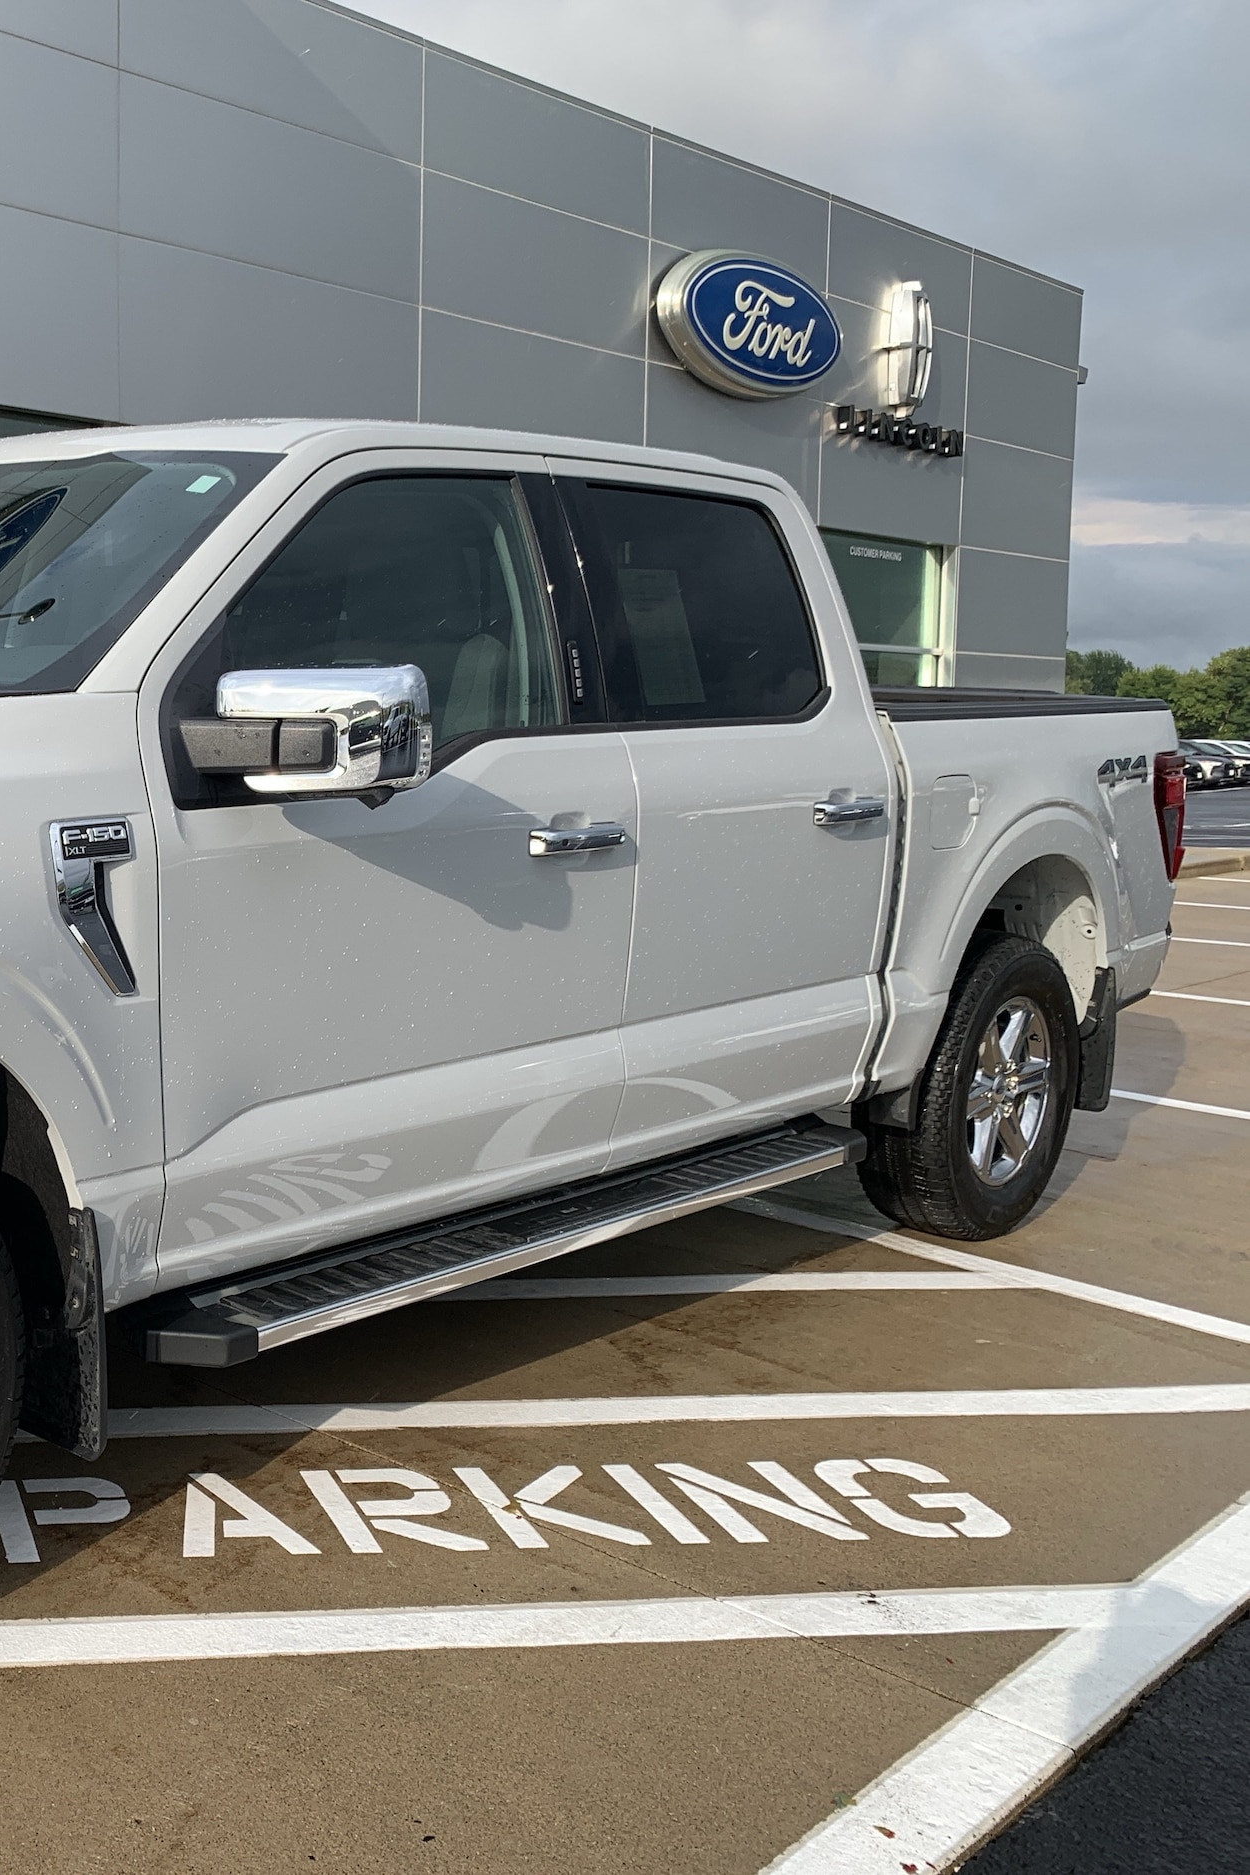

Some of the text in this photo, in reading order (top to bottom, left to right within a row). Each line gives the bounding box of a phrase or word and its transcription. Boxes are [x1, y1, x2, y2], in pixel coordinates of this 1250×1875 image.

[723, 280, 816, 367] Ford
[849, 545, 902, 562] CUSTOMER PARKING
[62, 825, 127, 845] F-150
[68, 846, 87, 856] XLT
